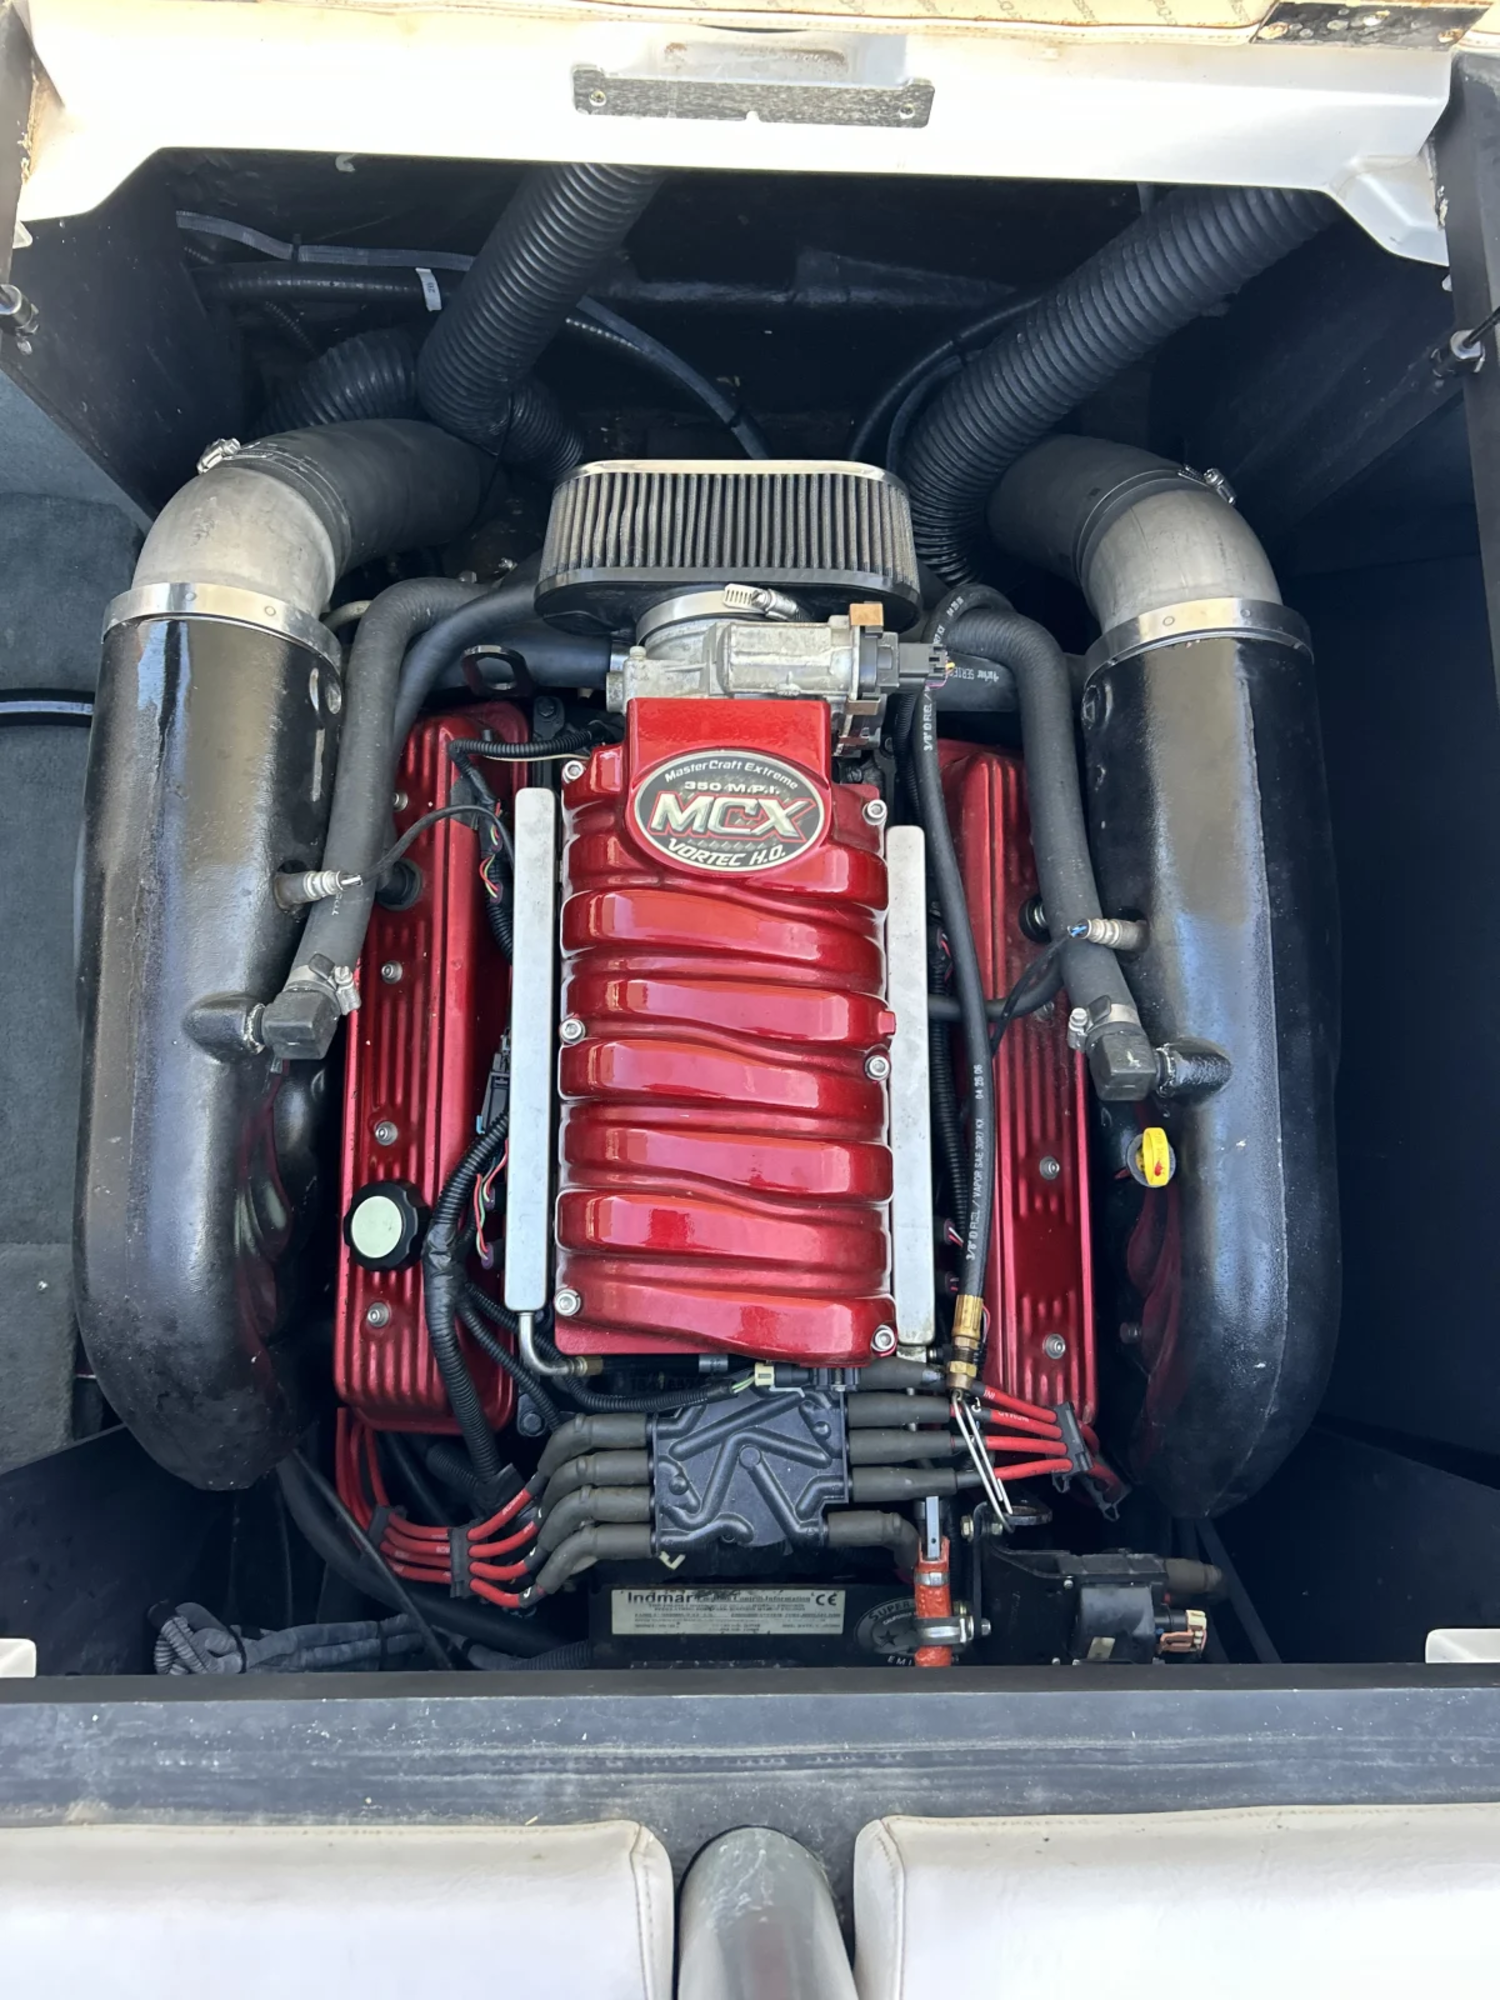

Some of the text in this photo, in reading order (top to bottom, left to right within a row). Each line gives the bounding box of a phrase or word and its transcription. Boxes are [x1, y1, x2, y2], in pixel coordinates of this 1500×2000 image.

[922, 703, 932, 722] FUEL
[664, 759, 799, 790] MasterCraft Extreme
[684, 780, 723, 791] 350
[650, 792, 811, 838] MCX
[668, 838, 746, 867] VORTEC
[974, 1151, 985, 1168] SAE
[972, 1170, 983, 1198] VAPOR
[970, 1210, 980, 1228] FUEL
[627, 1592, 692, 1604] Indmar
[815, 1592, 838, 1606] CE
[869, 1600, 911, 1621] SUPER
